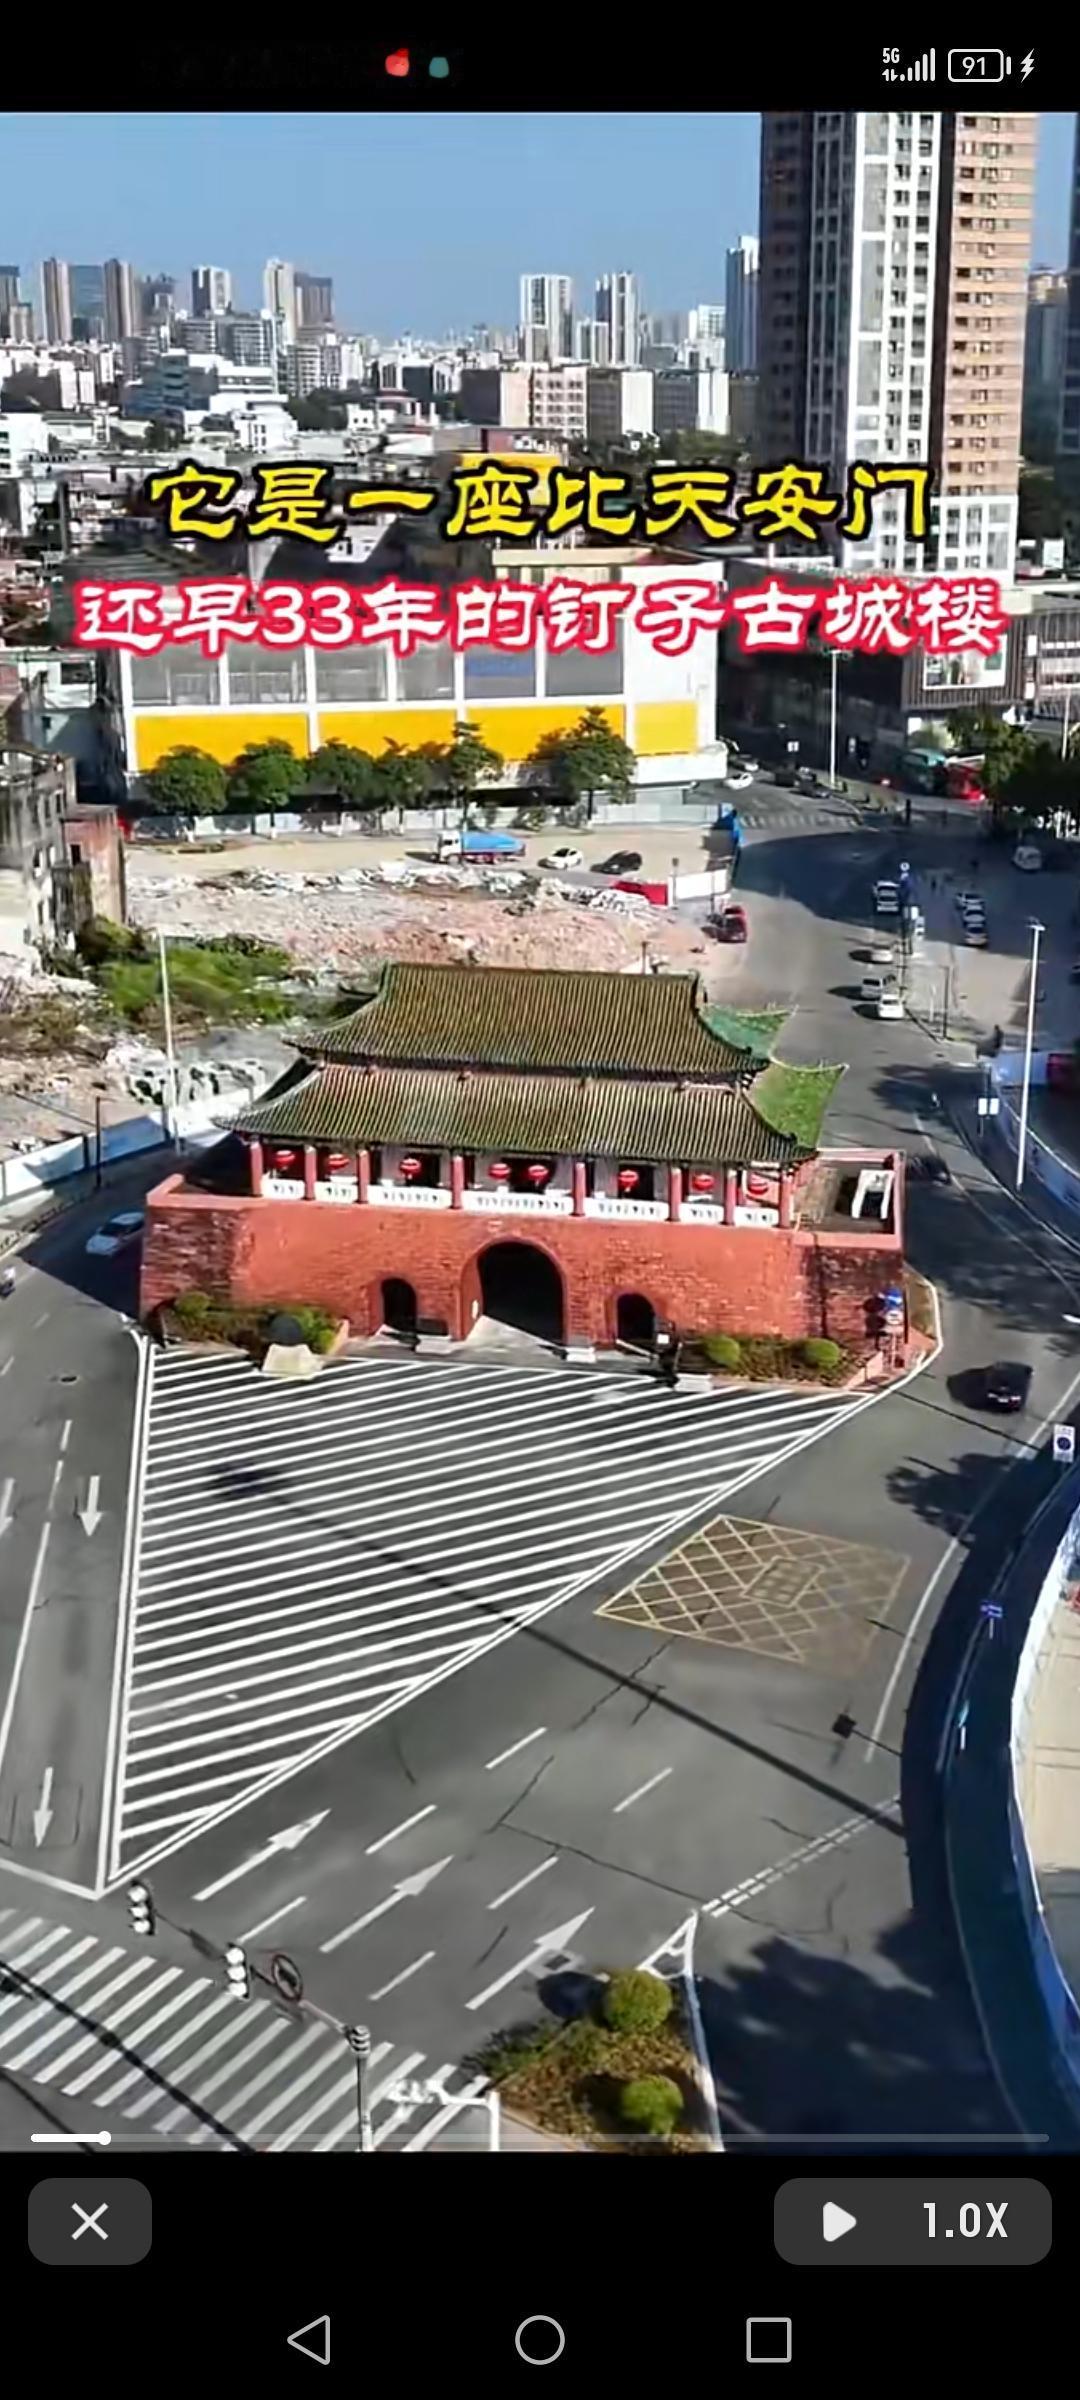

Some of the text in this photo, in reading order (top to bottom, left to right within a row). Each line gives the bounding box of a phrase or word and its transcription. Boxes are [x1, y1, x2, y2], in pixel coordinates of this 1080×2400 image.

[881, 47, 900, 64] 5G
[962, 56, 986, 76] 91
[923, 2202, 1009, 2238] 1.0X
